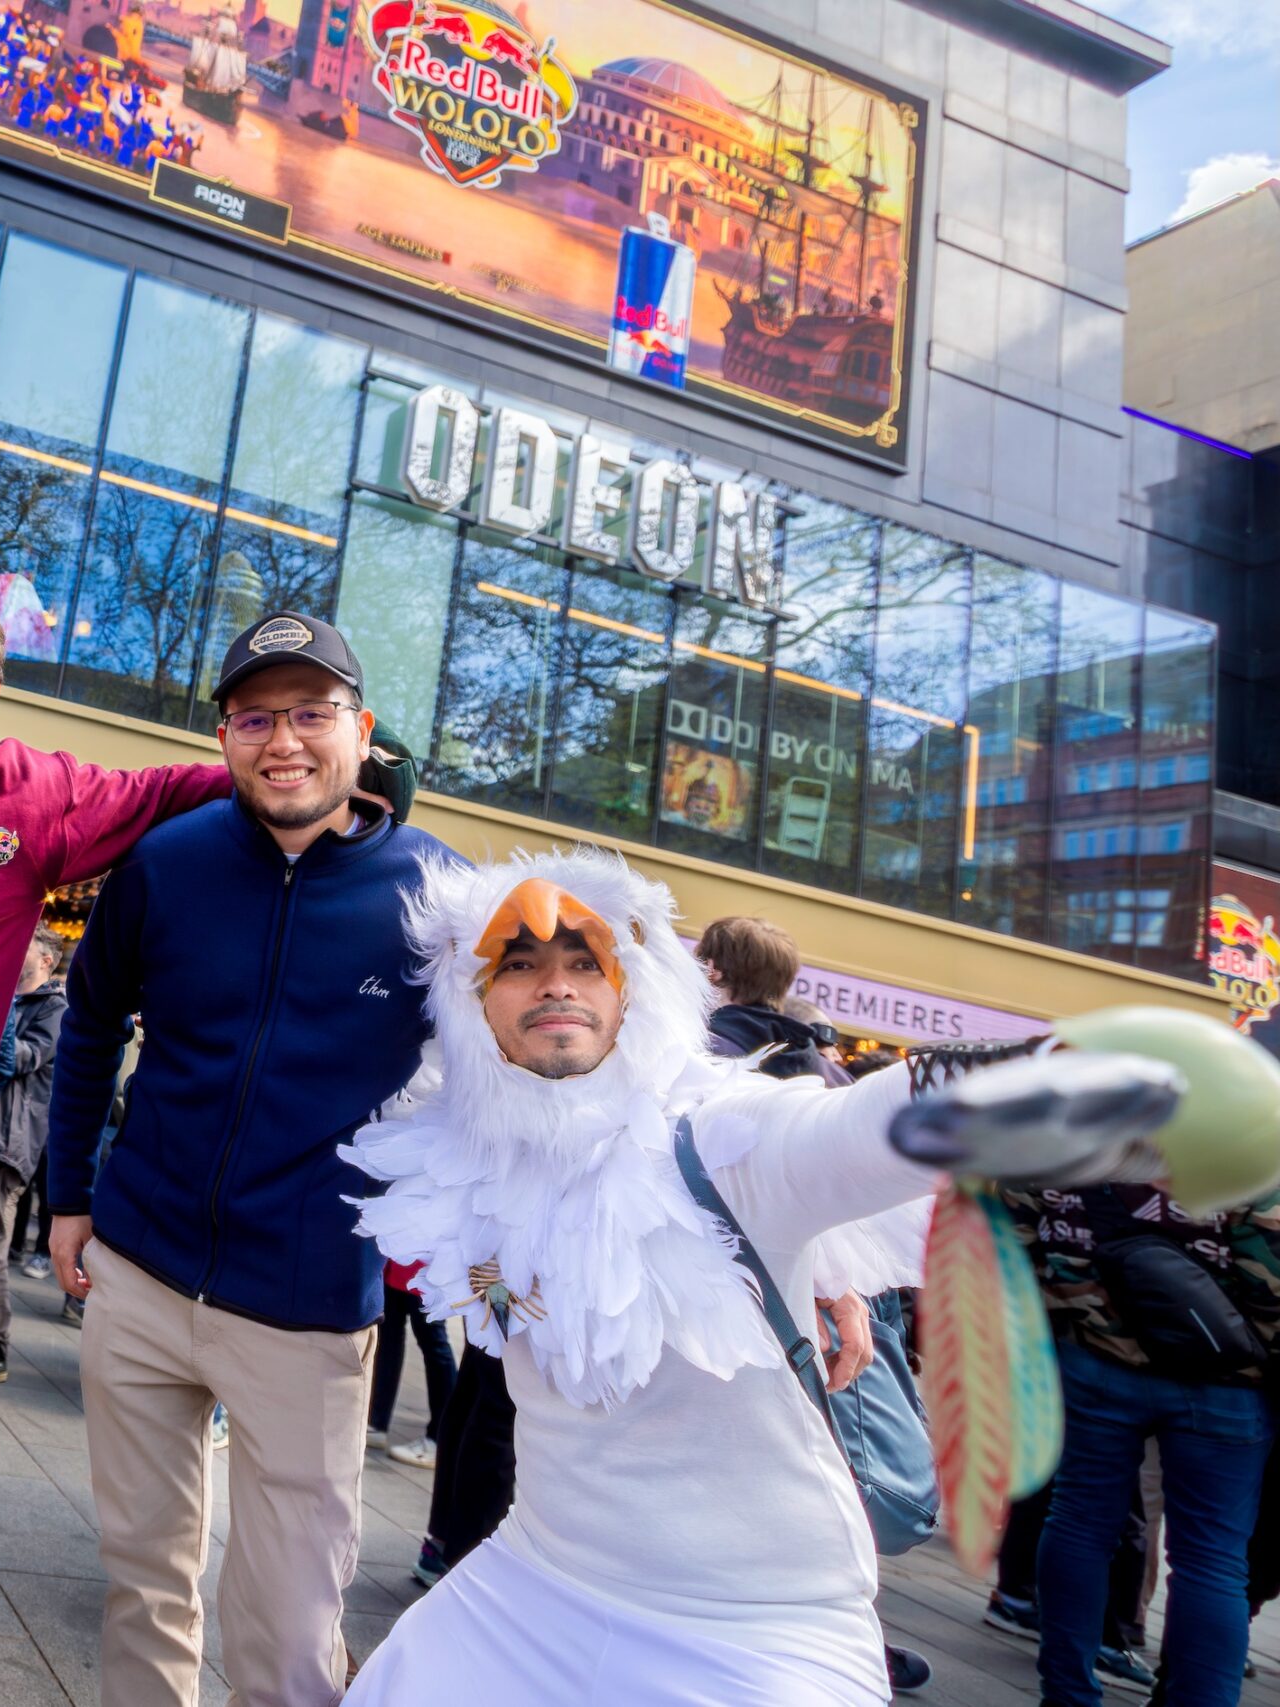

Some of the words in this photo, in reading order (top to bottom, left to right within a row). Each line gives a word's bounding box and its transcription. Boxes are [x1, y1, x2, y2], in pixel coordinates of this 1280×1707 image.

[402, 40, 471, 92] Red
[476, 66, 543, 119] Bull
[392, 74, 548, 156] WOLOLO
[653, 310, 688, 339] Bull
[399, 384, 779, 608] ODEON
[254, 630, 308, 646] COLOMBIA
[795, 977, 964, 1038] PREMIERES
